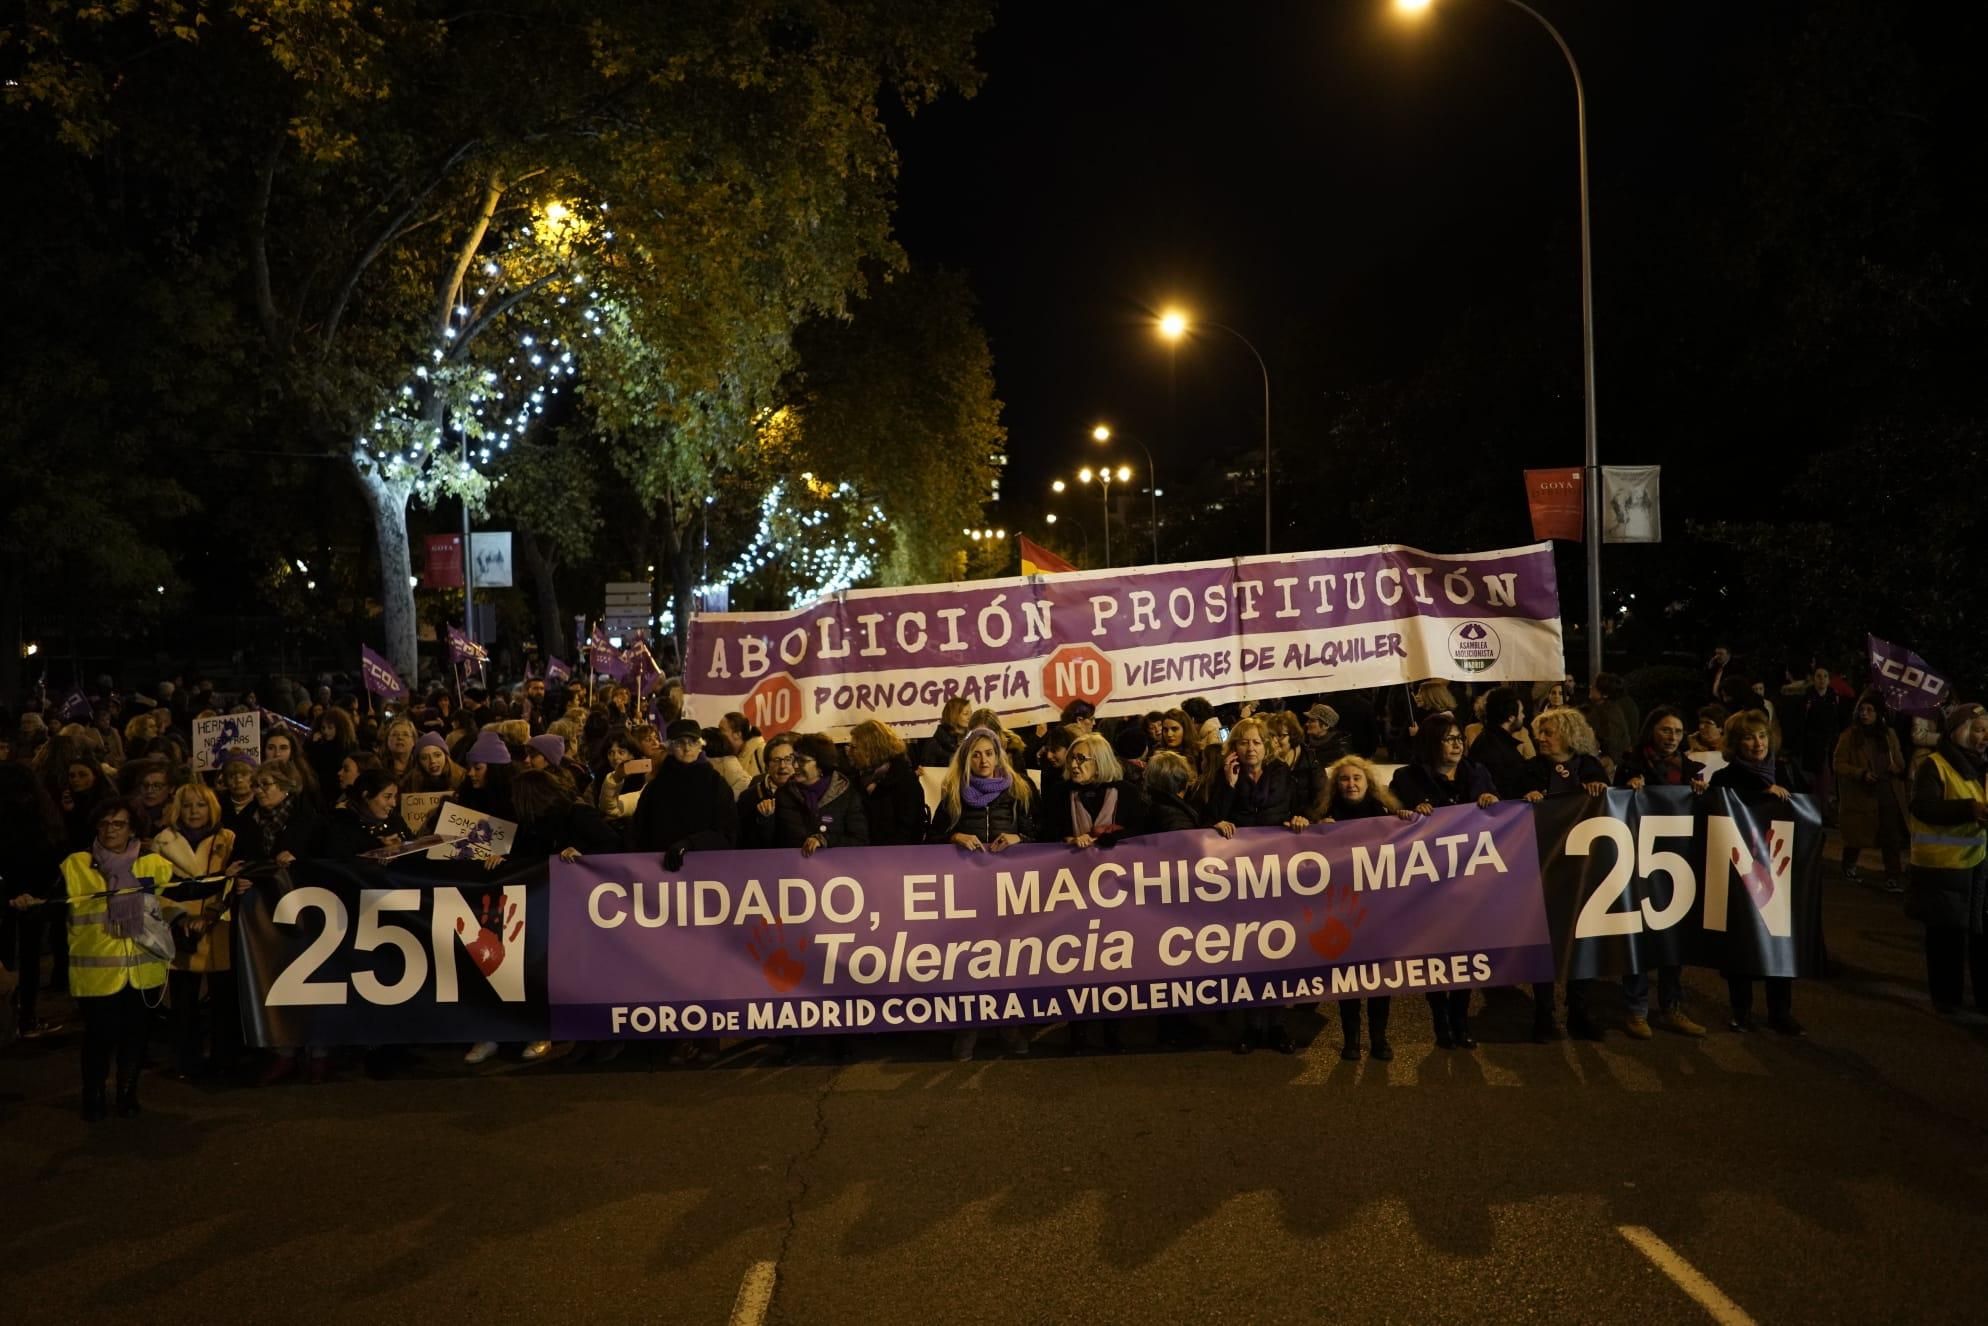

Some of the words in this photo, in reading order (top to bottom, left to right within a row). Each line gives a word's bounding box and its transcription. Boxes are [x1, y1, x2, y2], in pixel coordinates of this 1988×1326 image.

[1540, 482, 1574, 490] GOYA
[707, 594, 1054, 679] ABOLICIÓN
[1090, 567, 1518, 636] PROSTITUCIÓN
[814, 665, 1030, 714] PORNOGRAFÍA
[1055, 658, 1100, 697] NO
[1124, 648, 1232, 687] VIENTRES
[1239, 644, 1275, 671] DE
[1284, 632, 1407, 670] ALQUILER
[755, 688, 791, 728] NO
[588, 876, 880, 931] CUIDADO,
[903, 873, 976, 922] EL
[996, 851, 1331, 917] MACHISMO
[1351, 830, 1508, 892] MATA
[1564, 815, 1795, 939] 25N
[265, 885, 527, 1007] 25N
[813, 918, 1135, 985] Tolerancia
[1158, 919, 1297, 967] cero
[611, 1005, 708, 1034] FORO
[711, 1011, 740, 1032] DE
[747, 1000, 876, 1031] MADRID
[881, 992, 1026, 1025] CONTRA
[1032, 997, 1062, 1018] LA
[1067, 976, 1254, 1016] VIOLENCIA
[1261, 982, 1278, 1001] A
[1282, 976, 1324, 999] LAS
[1330, 952, 1493, 996] MUJERES
